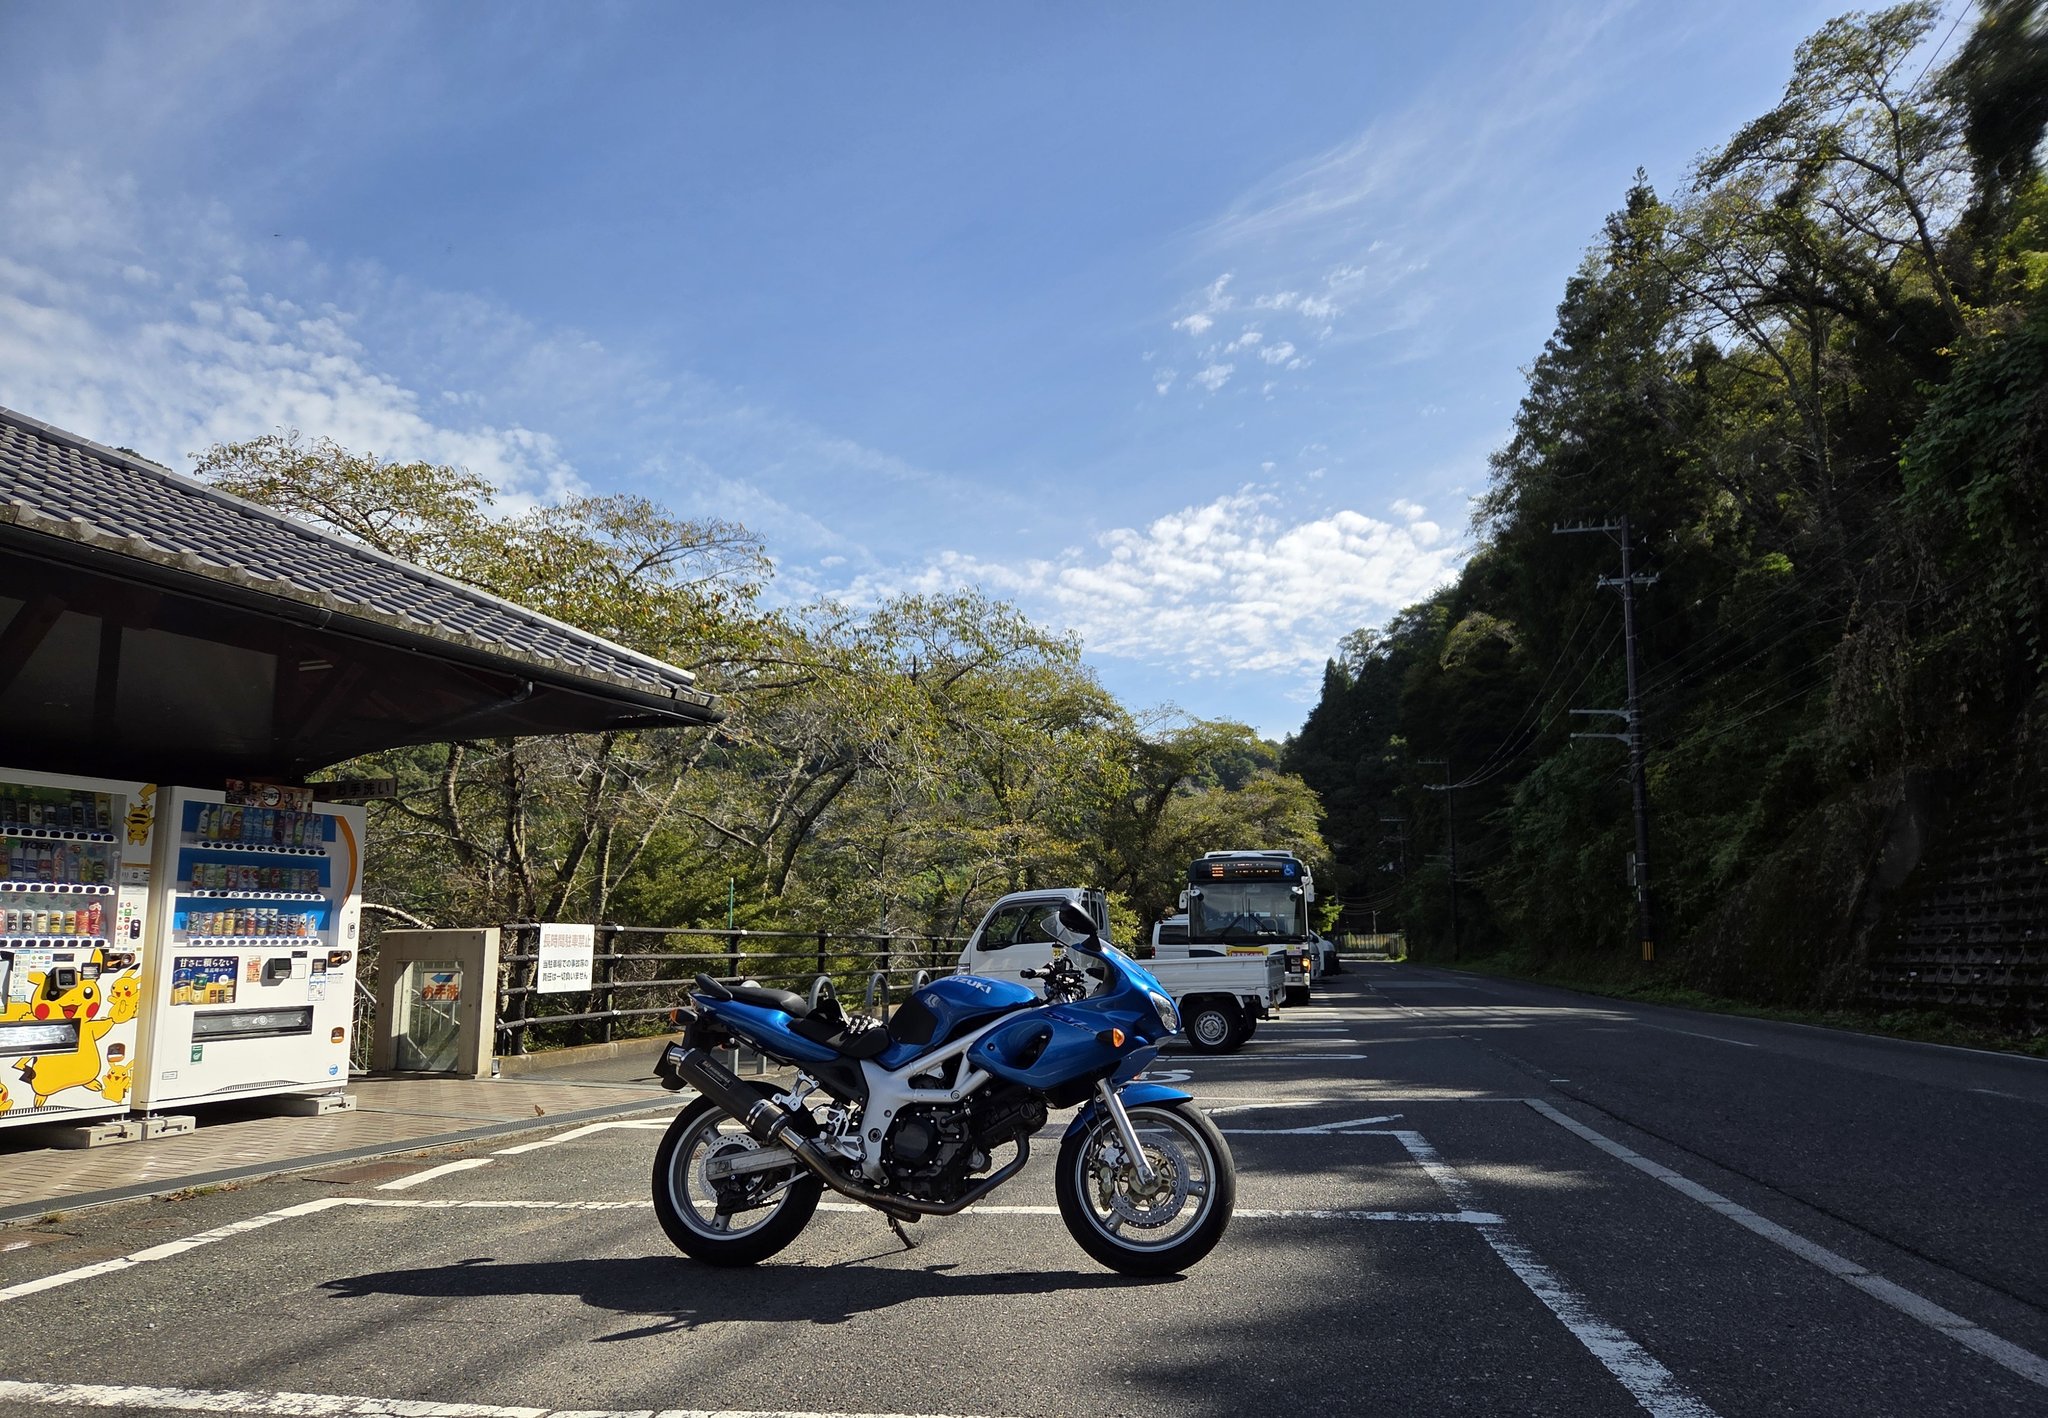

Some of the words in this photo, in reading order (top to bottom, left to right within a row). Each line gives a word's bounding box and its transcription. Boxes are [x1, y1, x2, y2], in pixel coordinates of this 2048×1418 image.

[336, 783, 390, 797] お手洗い
[543, 934, 591, 948] 長時間駐車禁止
[180, 958, 234, 967] 甘さに頼らない
